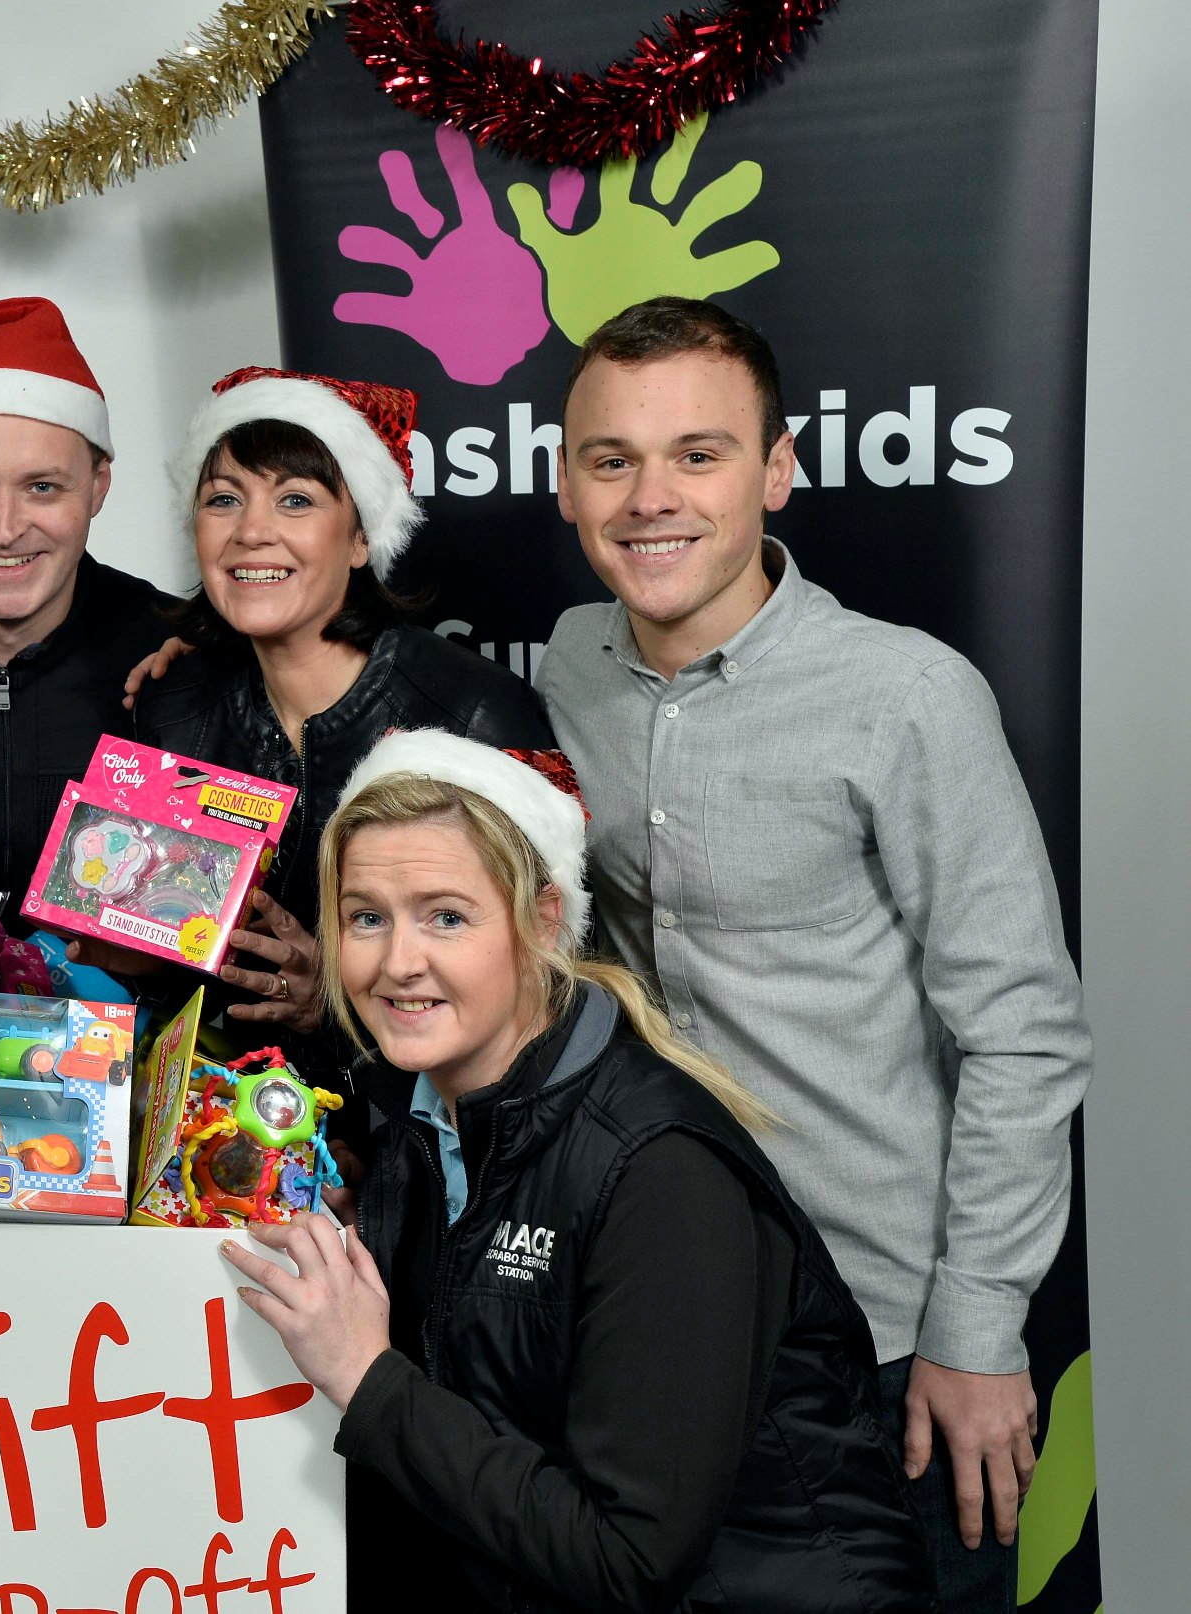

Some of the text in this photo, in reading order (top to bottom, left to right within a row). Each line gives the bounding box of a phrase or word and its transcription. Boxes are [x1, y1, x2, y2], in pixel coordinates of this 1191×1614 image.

[102, 753, 139, 768] Girls
[112, 768, 146, 789] Only
[215, 776, 250, 792] BEAUTY
[248, 785, 282, 800] QUEEN
[208, 789, 275, 818] COSMETICS
[224, 812, 254, 828] GLAMOROUS
[253, 822, 263, 831] TOO
[107, 914, 179, 947] STAND OUT STYLE!
[194, 928, 207, 944] 4
[196, 949, 205, 957] SET
[491, 1220, 556, 1260] MACE
[521, 1254, 550, 1272] SERVICE
[496, 1265, 534, 1282] STATION
